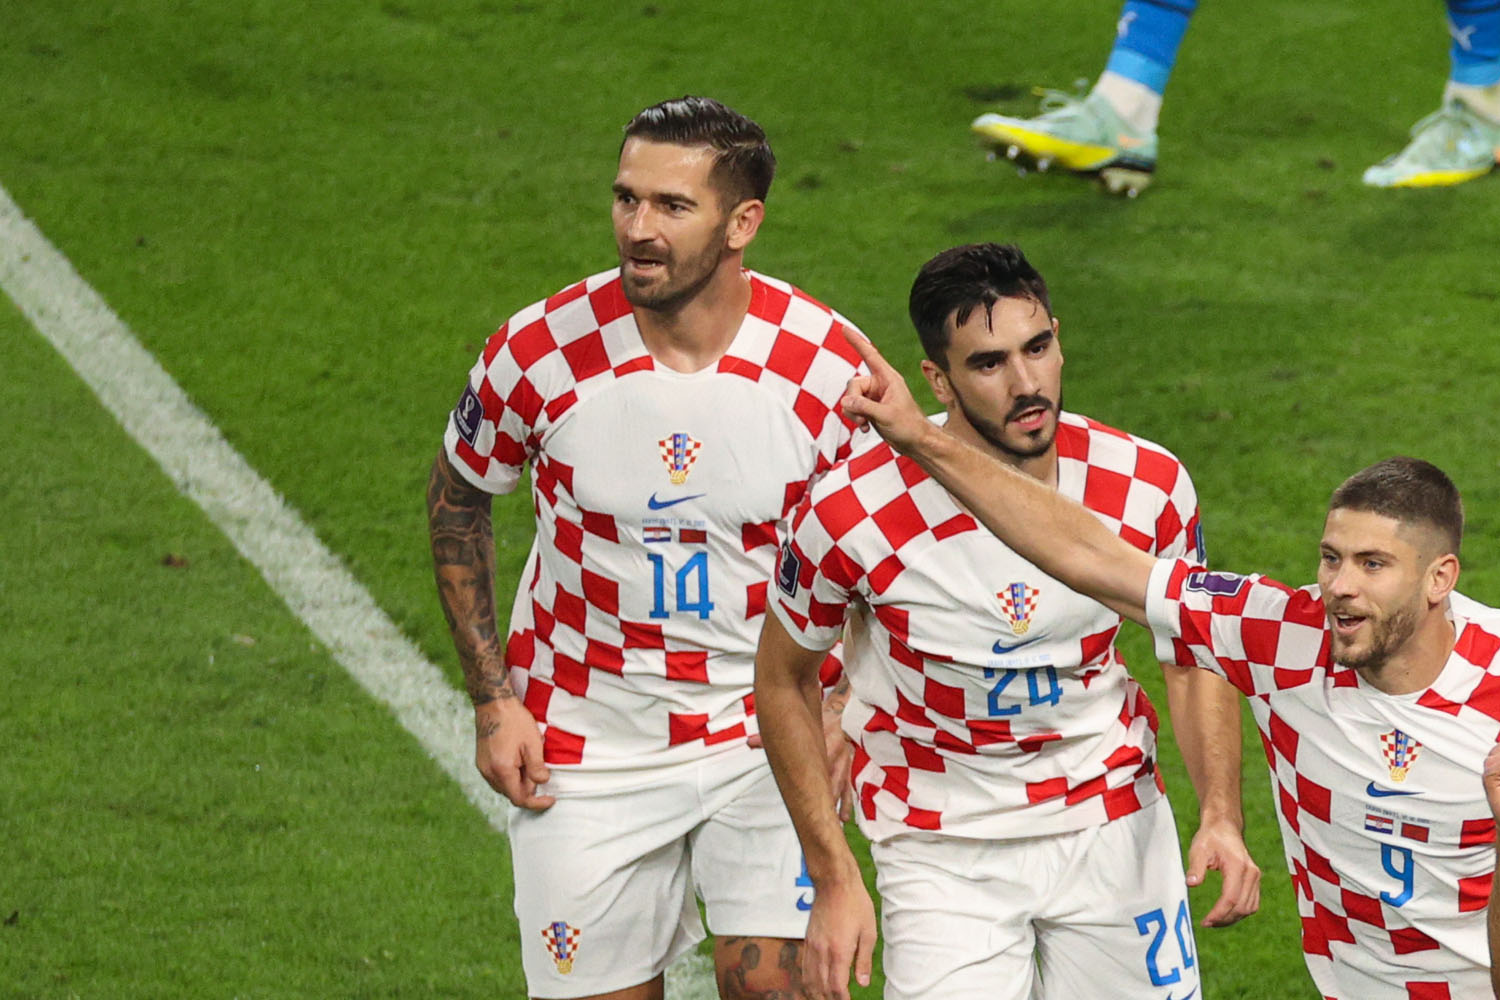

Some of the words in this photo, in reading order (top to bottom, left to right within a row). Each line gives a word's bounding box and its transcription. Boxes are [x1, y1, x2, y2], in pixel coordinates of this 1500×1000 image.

[647, 551, 714, 619] 14
[983, 664, 1063, 717] 24
[1380, 842, 1414, 908] 9
